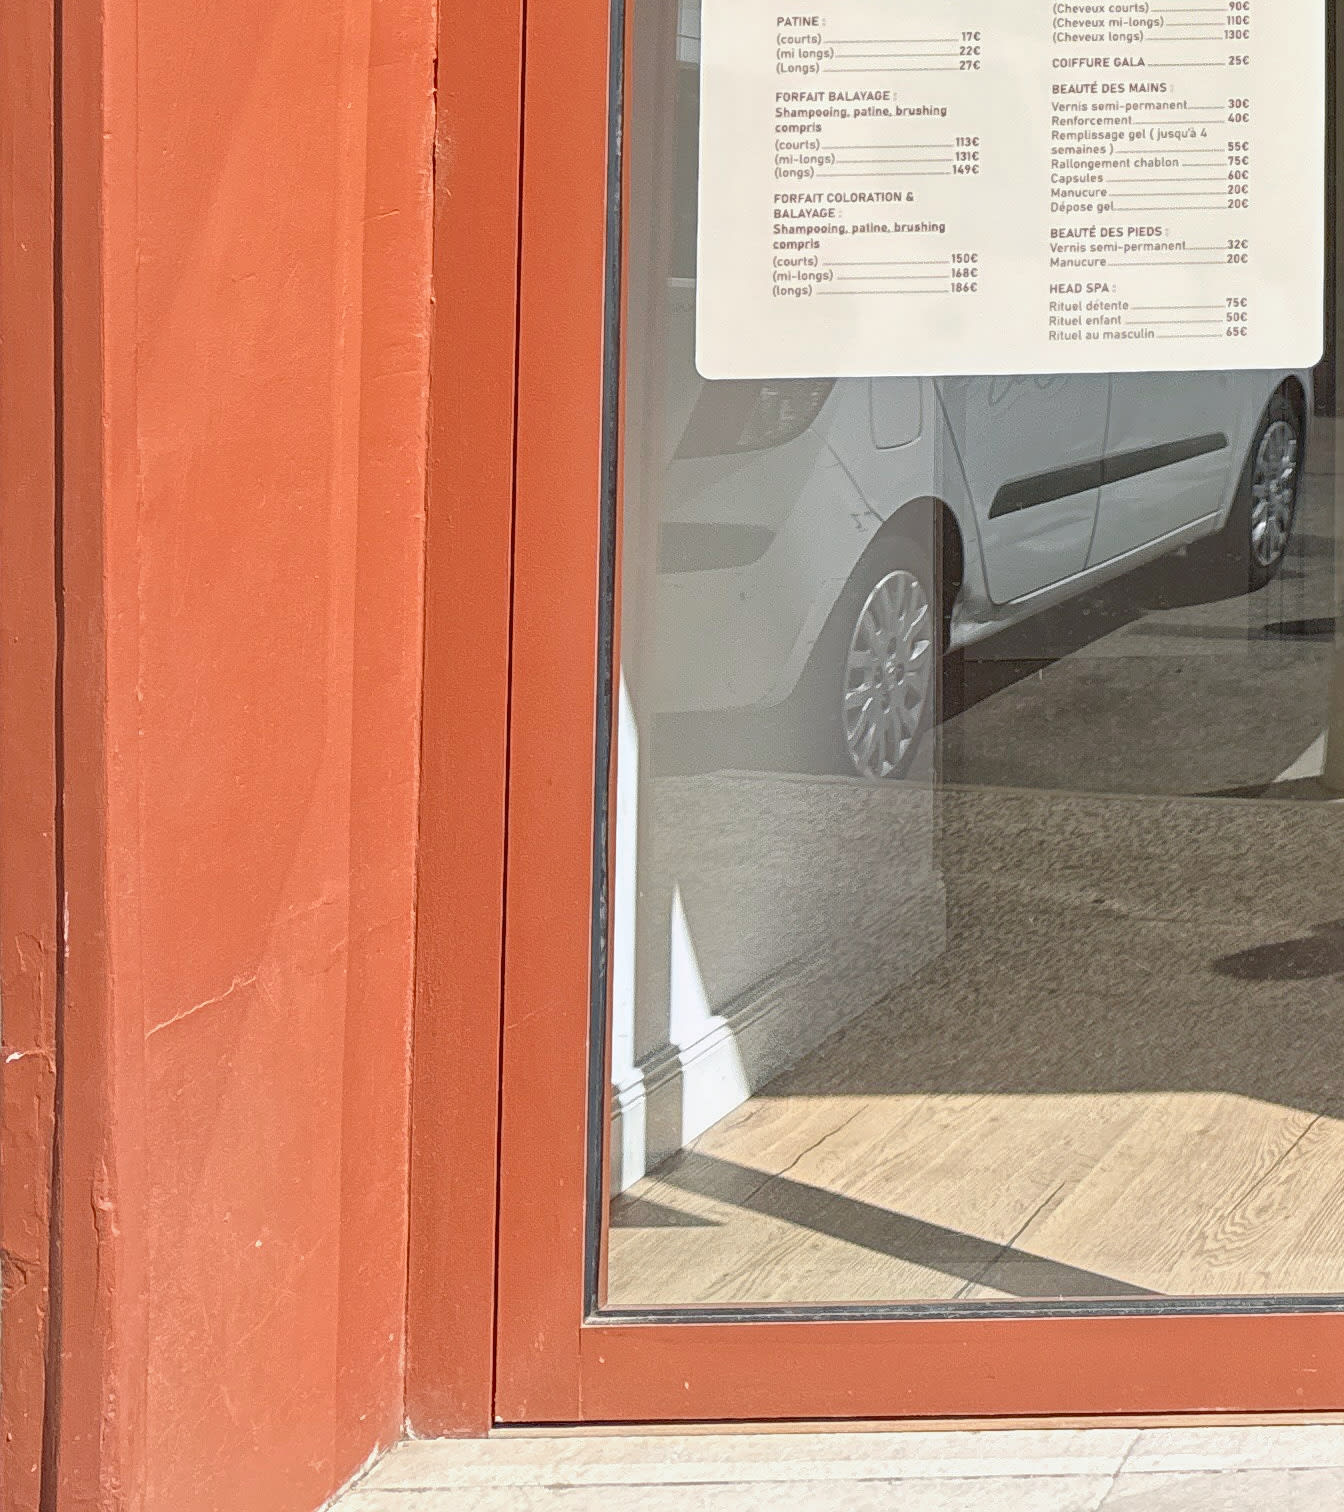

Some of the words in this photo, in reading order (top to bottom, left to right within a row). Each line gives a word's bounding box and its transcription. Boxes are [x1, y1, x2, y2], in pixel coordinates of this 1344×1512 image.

[777, 17, 819, 26] PATINE
[777, 33, 822, 45] (courts)
[962, 32, 981, 41] 17€
[1053, 58, 1110, 68] COIFFURE
[1114, 58, 1145, 67] GALA
[1229, 56, 1249, 65] 25€
[1052, 81, 1097, 94] BEAUTÉ
[1102, 84, 1125, 93] DES
[1129, 83, 1167, 92] MAINS
[776, 92, 825, 102] FORFAIT
[829, 91, 890, 101] BALAYAGE
[774, 167, 814, 179] (longs)
[952, 165, 979, 174] 149€
[774, 194, 823, 203] FORFAIT
[827, 192, 901, 203] COLORATION
[906, 192, 914, 201] &
[774, 208, 835, 218] BALAYAGE
[1051, 225, 1096, 238] BEAUTÉ
[1101, 228, 1123, 237] DES
[1128, 227, 1162, 237] PIEDS
[773, 286, 812, 297] (longs)
[951, 283, 978, 292] 186€
[1050, 284, 1082, 293] HEAD
[1086, 283, 1109, 292] SPA
[1049, 302, 1082, 311] Rituel
[1086, 300, 1129, 310] détente
[1226, 298, 1247, 307] 75€
[1049, 316, 1082, 325] Rituel
[1086, 315, 1121, 325] enfant
[1226, 312, 1247, 321] 50€
[1049, 330, 1082, 340] Rituel
[1086, 331, 1099, 339] au
[1103, 328, 1154, 339] masculin
[1226, 327, 1247, 336] 65€
